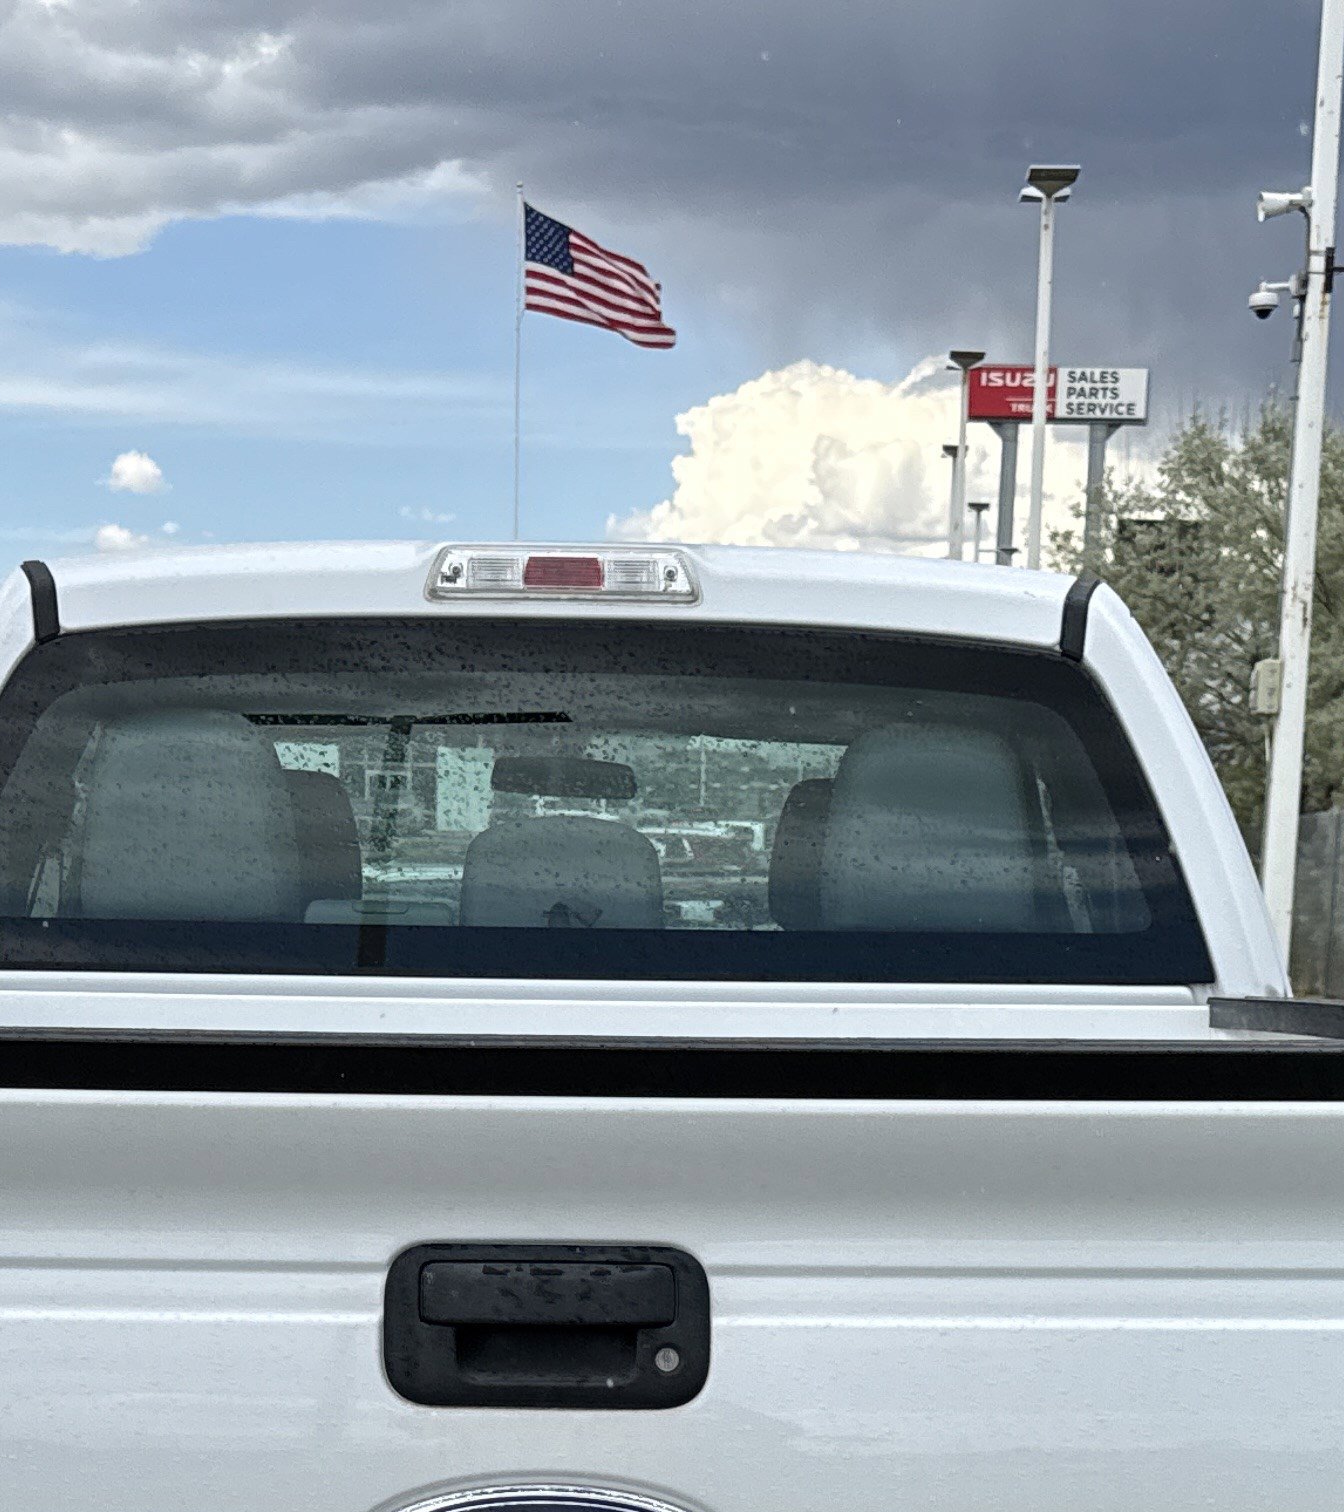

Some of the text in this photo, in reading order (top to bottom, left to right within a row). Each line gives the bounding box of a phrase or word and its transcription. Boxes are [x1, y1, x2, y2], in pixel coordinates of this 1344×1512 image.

[1067, 371, 1120, 383] SALES
[1066, 387, 1120, 400] PARTS
[1009, 403, 1053, 413] TRUK
[1066, 402, 1136, 416] SERVICE
